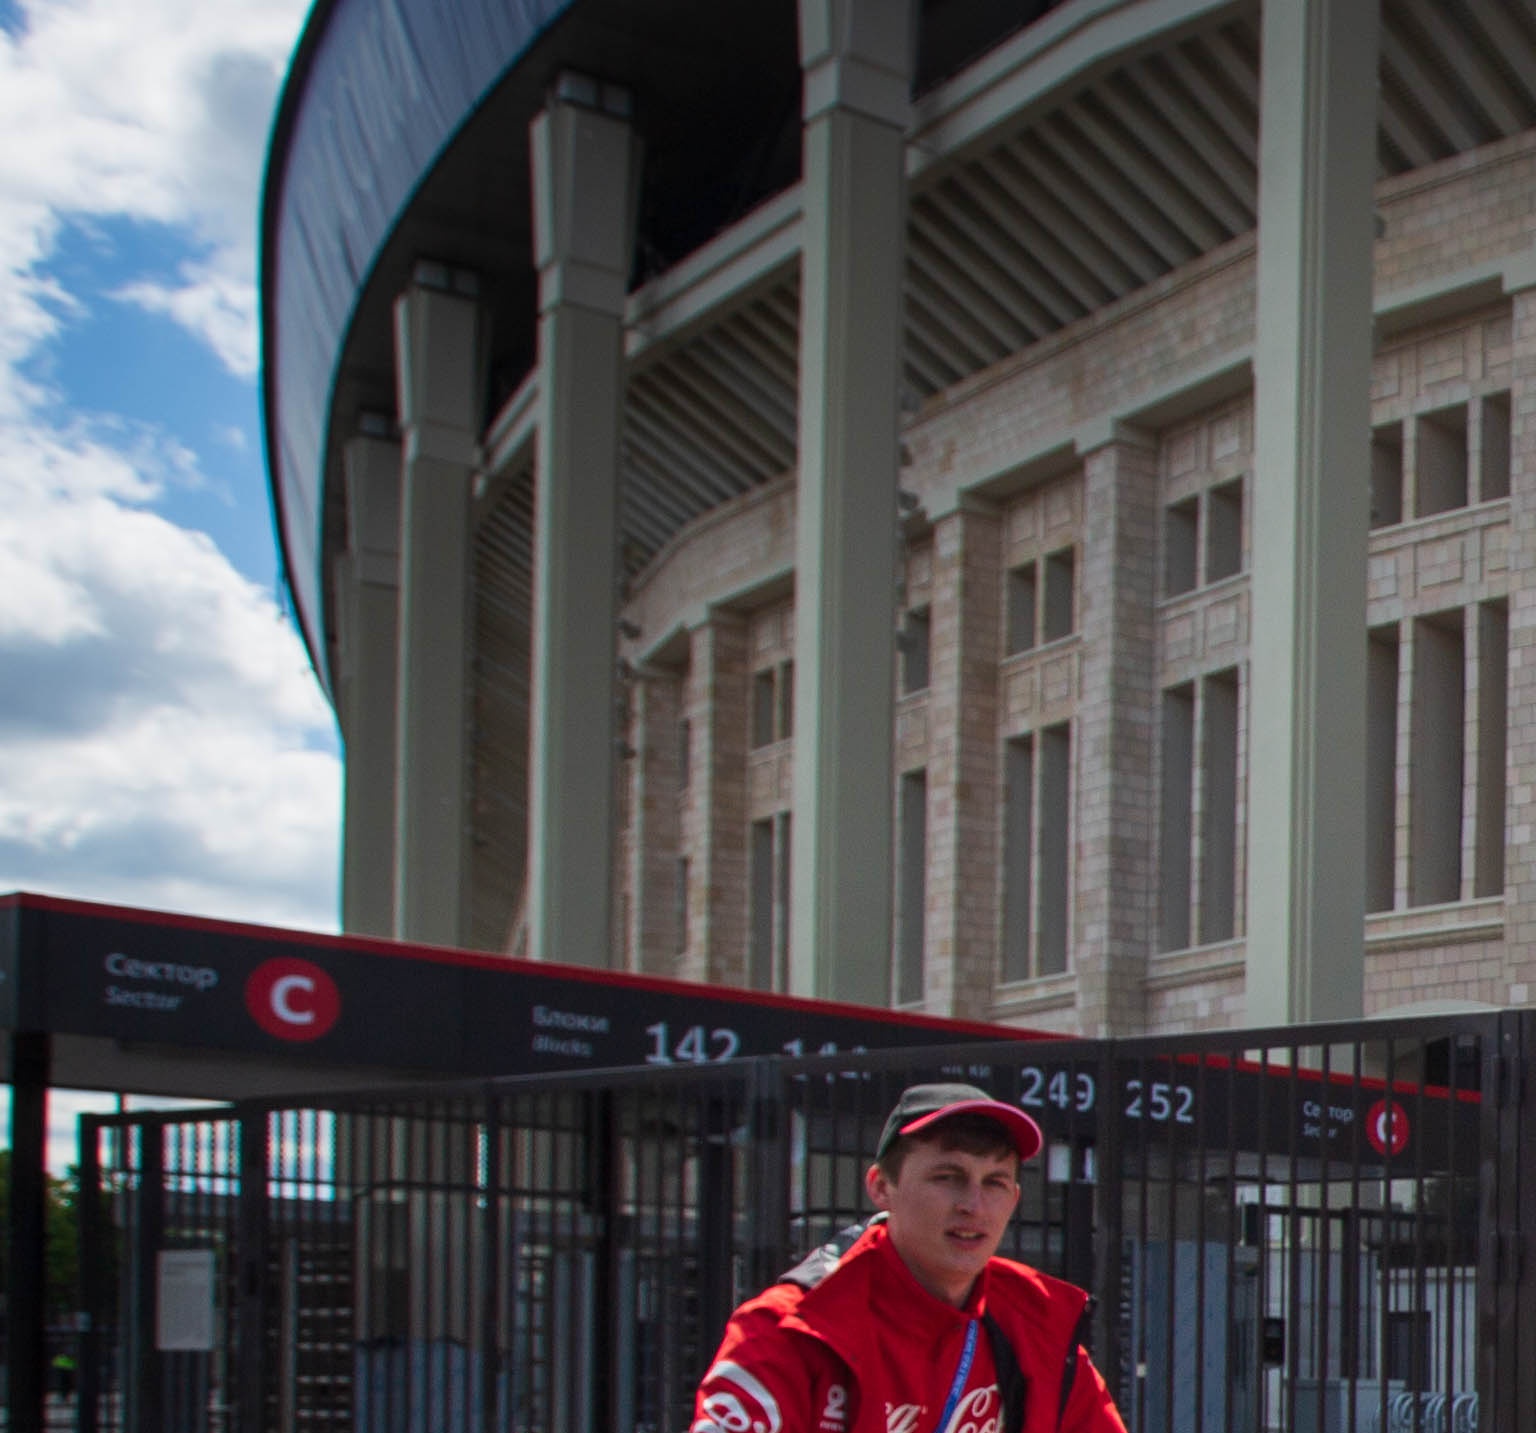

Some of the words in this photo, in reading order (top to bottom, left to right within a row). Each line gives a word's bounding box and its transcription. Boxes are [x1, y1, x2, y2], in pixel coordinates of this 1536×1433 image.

[105, 953, 219, 988] Сектор
[532, 1005, 609, 1034] Блоки
[646, 1021, 740, 1065] 142
[1020, 1067, 1094, 1112] 249
[1125, 1080, 1194, 1123] 252
[1303, 1101, 1354, 1123] Сетор
